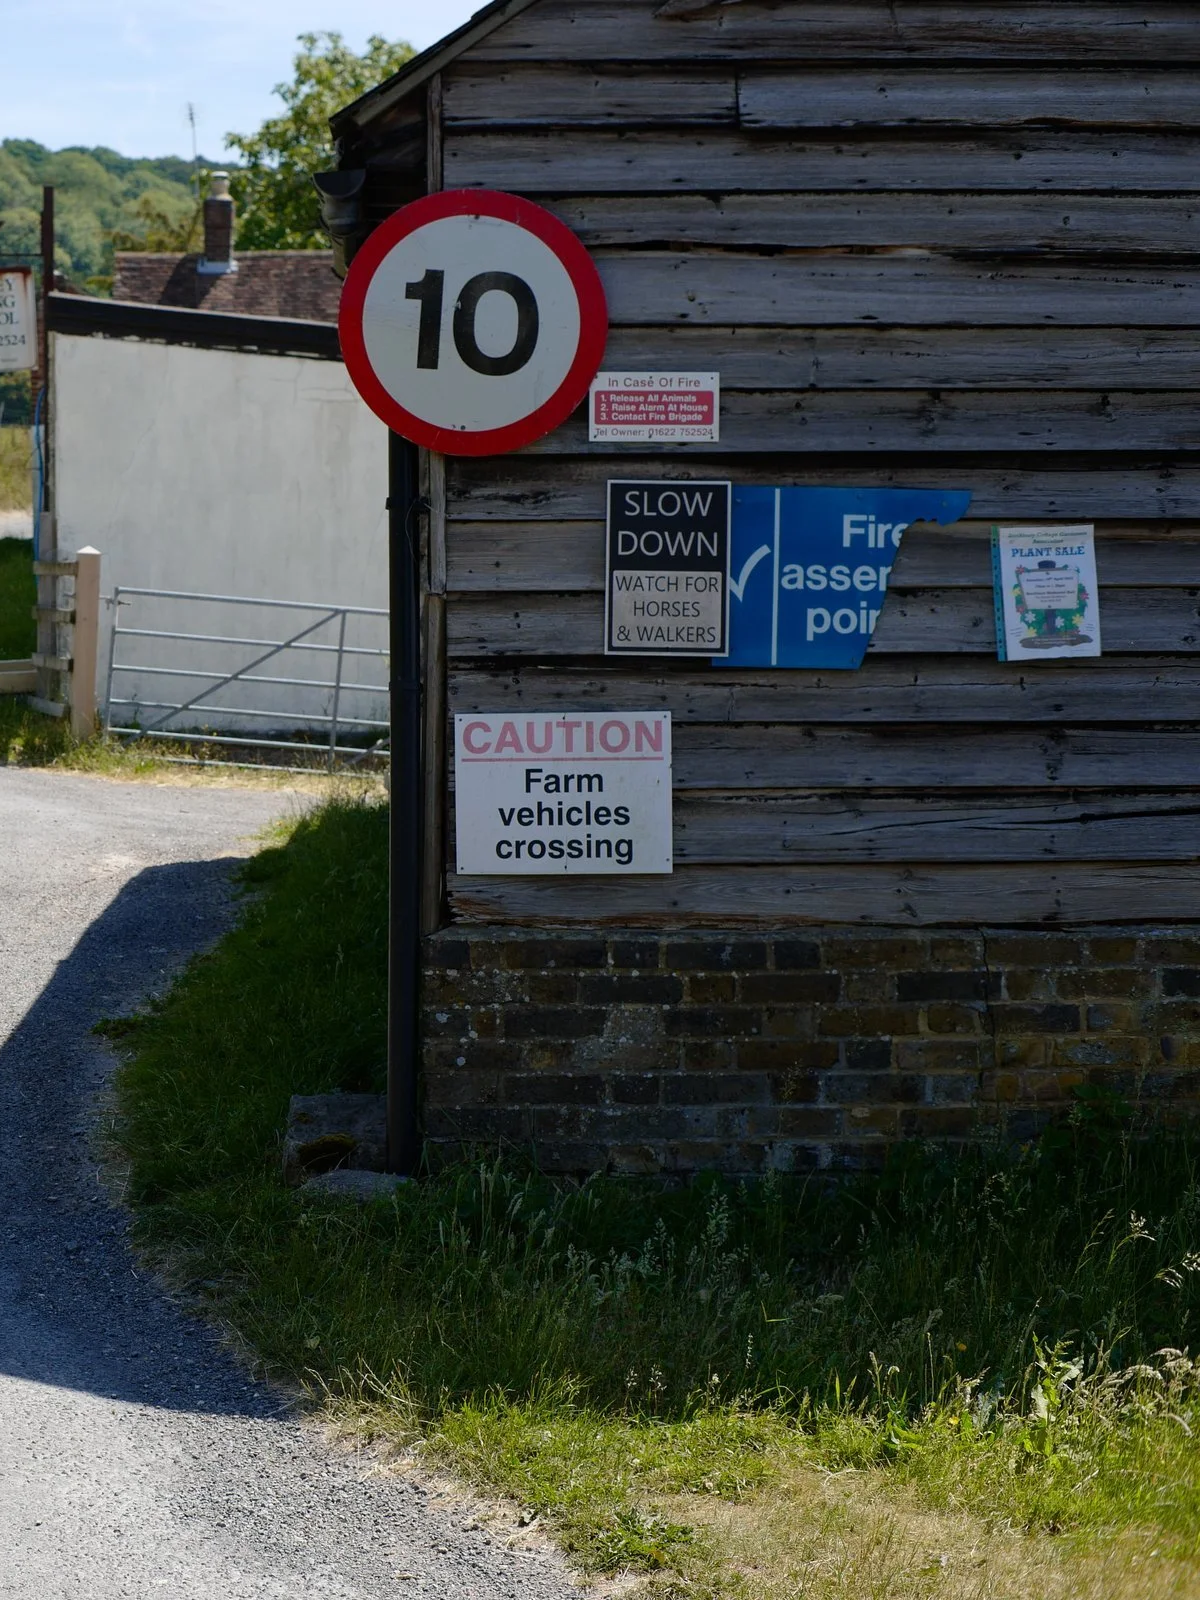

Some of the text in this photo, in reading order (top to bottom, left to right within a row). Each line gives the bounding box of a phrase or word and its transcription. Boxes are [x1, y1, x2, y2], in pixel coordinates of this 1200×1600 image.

[405, 269, 539, 377] 10
[608, 378, 701, 387] In Case Of Fire
[601, 394, 697, 402] 1. Release All Animals
[600, 403, 708, 411] 2. Raise Alarm At House
[600, 413, 703, 422] 3. Contact Fire Brigade
[595, 428, 713, 436] Tel Owner: 01622 752524
[624, 491, 713, 517] SLOW
[617, 531, 718, 557] DOWN
[1011, 546, 1085, 558] PLANT SALE
[615, 575, 719, 593] WATCH FOR
[633, 601, 701, 618] HORSES
[616, 626, 717, 643] & WALKERS
[463, 720, 663, 754] CAUTION
[525, 768, 604, 793] Farm
[498, 801, 631, 826] vehicles
[496, 834, 634, 865] crossing
